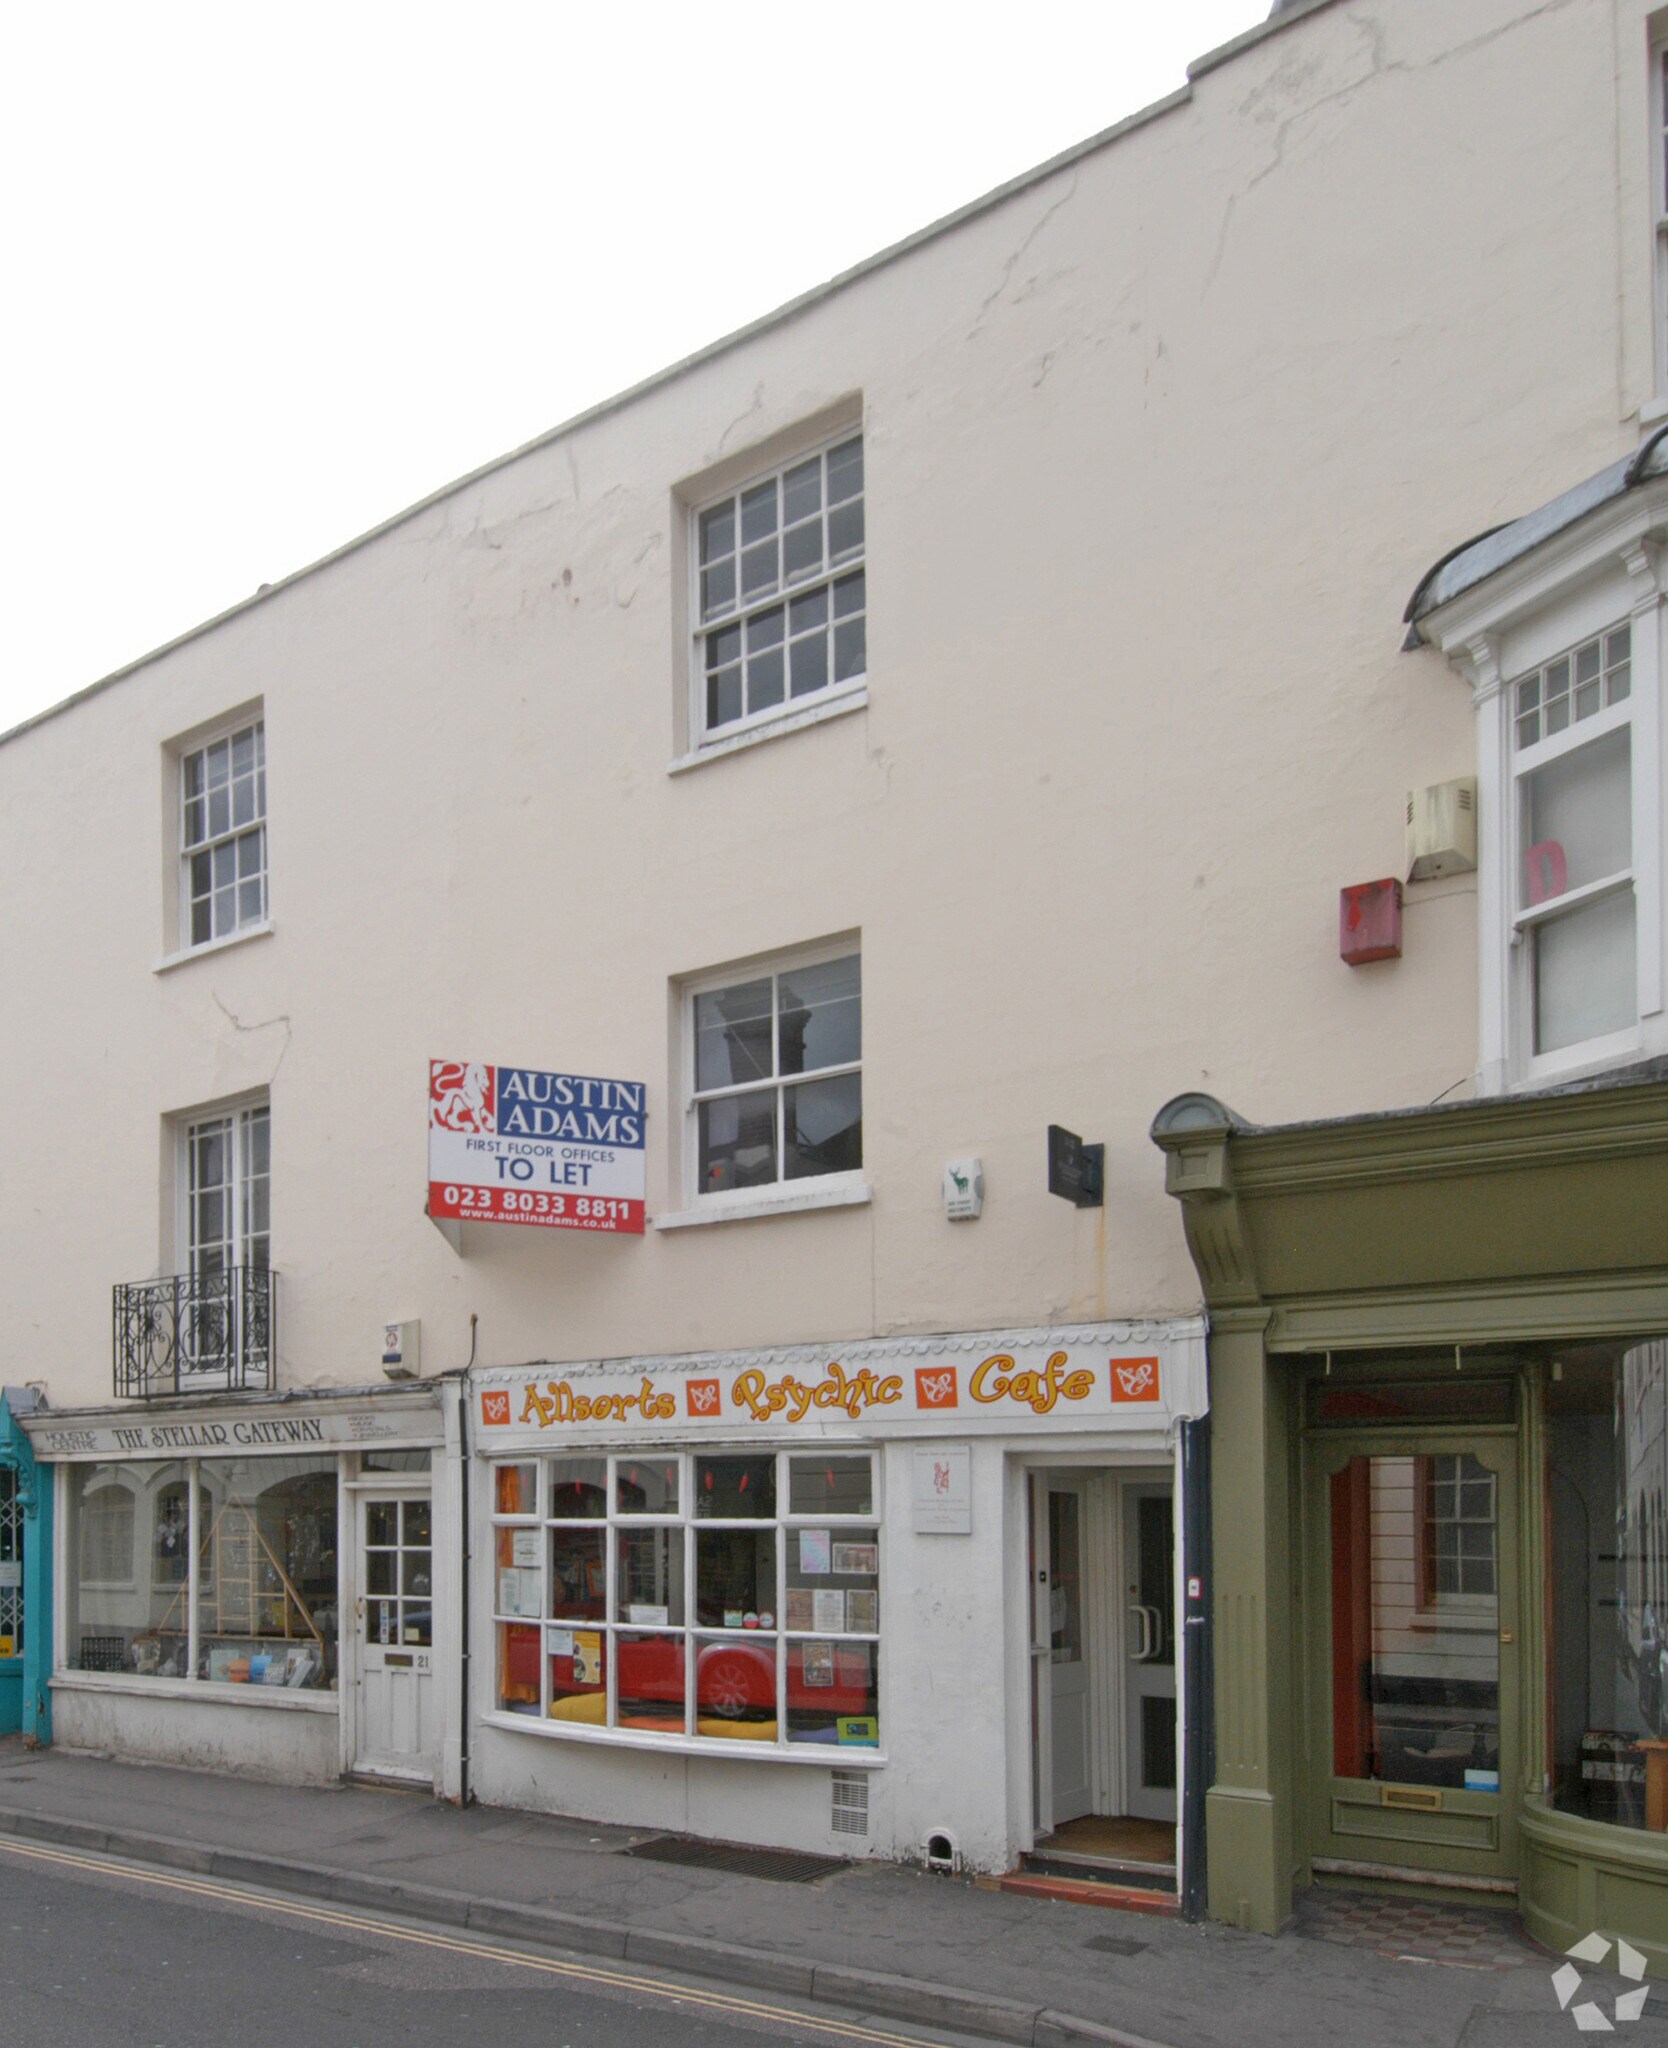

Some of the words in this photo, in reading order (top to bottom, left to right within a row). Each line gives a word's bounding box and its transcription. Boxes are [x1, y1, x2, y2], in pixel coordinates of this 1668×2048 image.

[501, 1071, 642, 1112] AUSTIN
[503, 1104, 640, 1145] ADAMS
[466, 1138, 502, 1153] FIRST
[508, 1142, 554, 1158] FLOOR
[561, 1147, 616, 1164] OFFICES
[494, 1156, 534, 1181] TO
[550, 1160, 592, 1187] LET
[444, 1186, 492, 1208] 023
[502, 1192, 565, 1214] 8033
[576, 1198, 629, 1220] 8811
[459, 1207, 617, 1230] www.austinadams.co.uk
[519, 1376, 676, 1428] Allsorts
[731, 1362, 904, 1423] Psychic
[969, 1350, 1096, 1414] Cafe
[45, 1430, 97, 1442] HOLISTIC
[52, 1440, 98, 1451] CENTRE
[112, 1428, 148, 1449] THE
[151, 1424, 230, 1448] STELLAR
[233, 1418, 323, 1444] GATEWAY
[417, 1654, 429, 1669] 21
